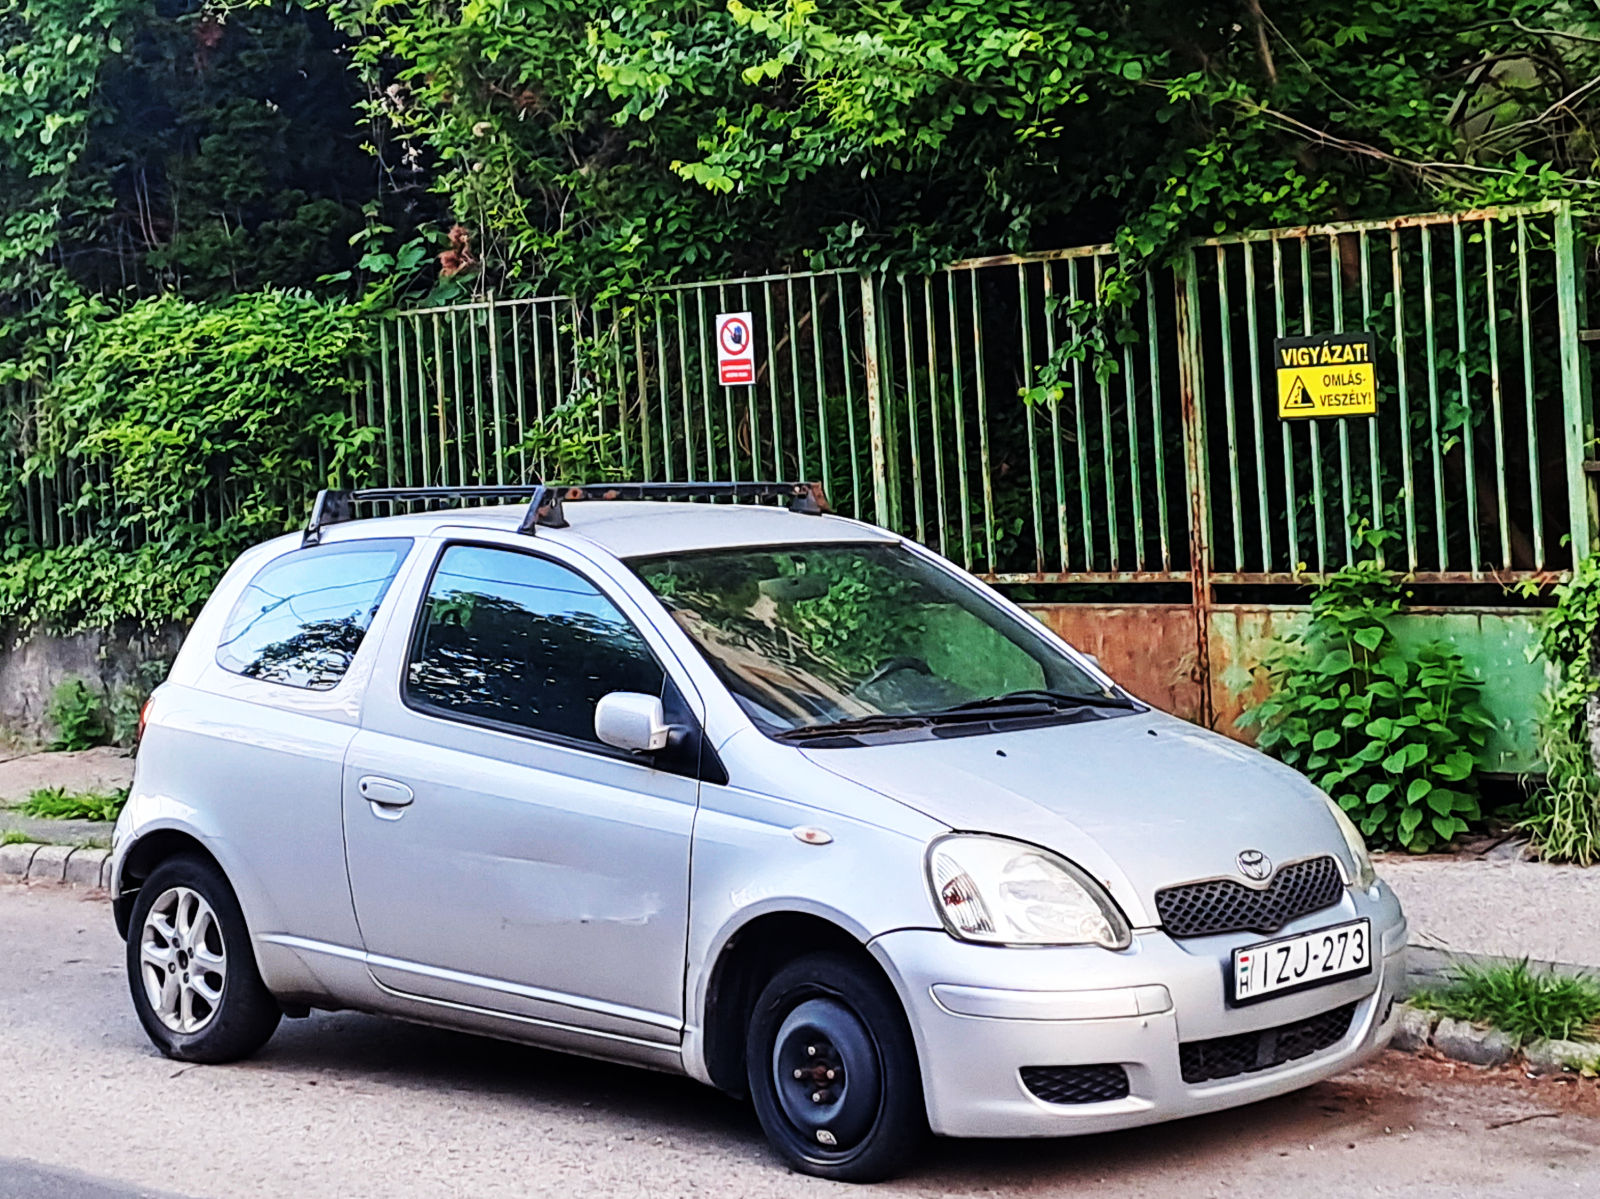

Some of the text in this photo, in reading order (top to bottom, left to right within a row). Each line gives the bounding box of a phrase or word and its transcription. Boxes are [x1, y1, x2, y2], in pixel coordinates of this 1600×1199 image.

[1281, 340, 1368, 366] VIGYÁZAT!
[1322, 370, 1366, 387] OMLÁS-
[1320, 390, 1372, 407] VESZÉLY!
[1263, 928, 1364, 988] IZJ-273
[1240, 976, 1249, 995] H
